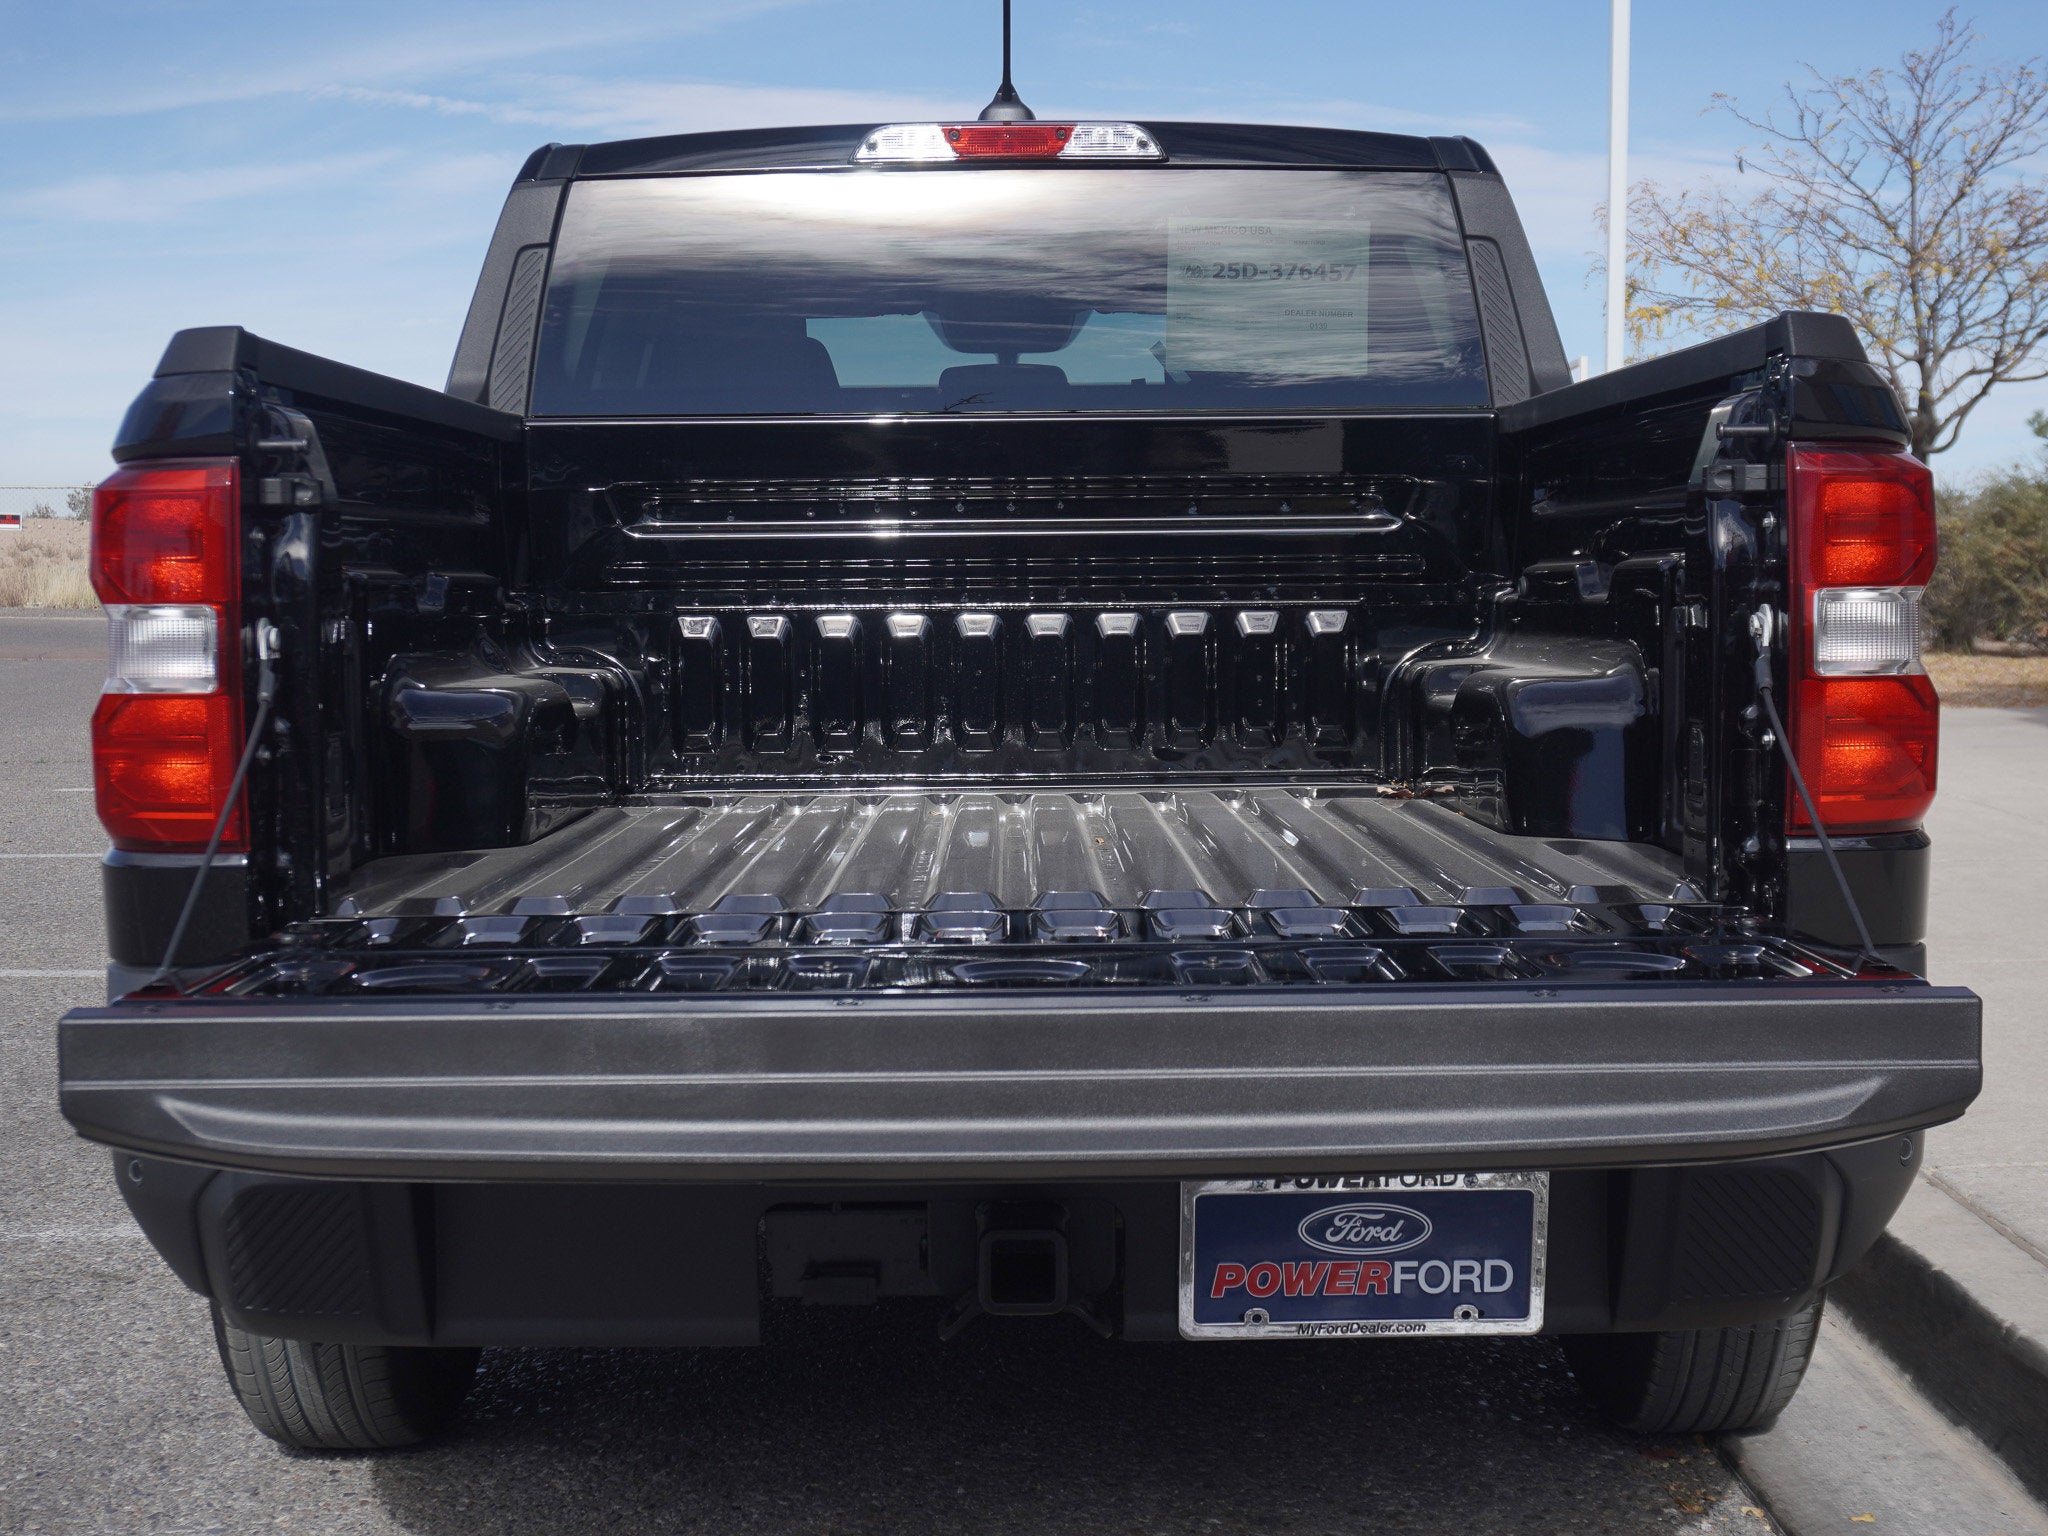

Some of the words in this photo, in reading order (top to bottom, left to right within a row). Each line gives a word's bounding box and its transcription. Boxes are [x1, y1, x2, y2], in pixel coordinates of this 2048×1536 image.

[1176, 226, 1200, 234] NEW
[1204, 226, 1247, 235] MEXICO
[1250, 226, 1273, 235] USA
[1212, 262, 1358, 282] 25D-376457
[1284, 309, 1317, 317] DEALER
[1319, 310, 1354, 318] NUMBER
[1325, 1211, 1405, 1244] Ford
[1297, 1321, 1427, 1336] MyFordDealer.com
